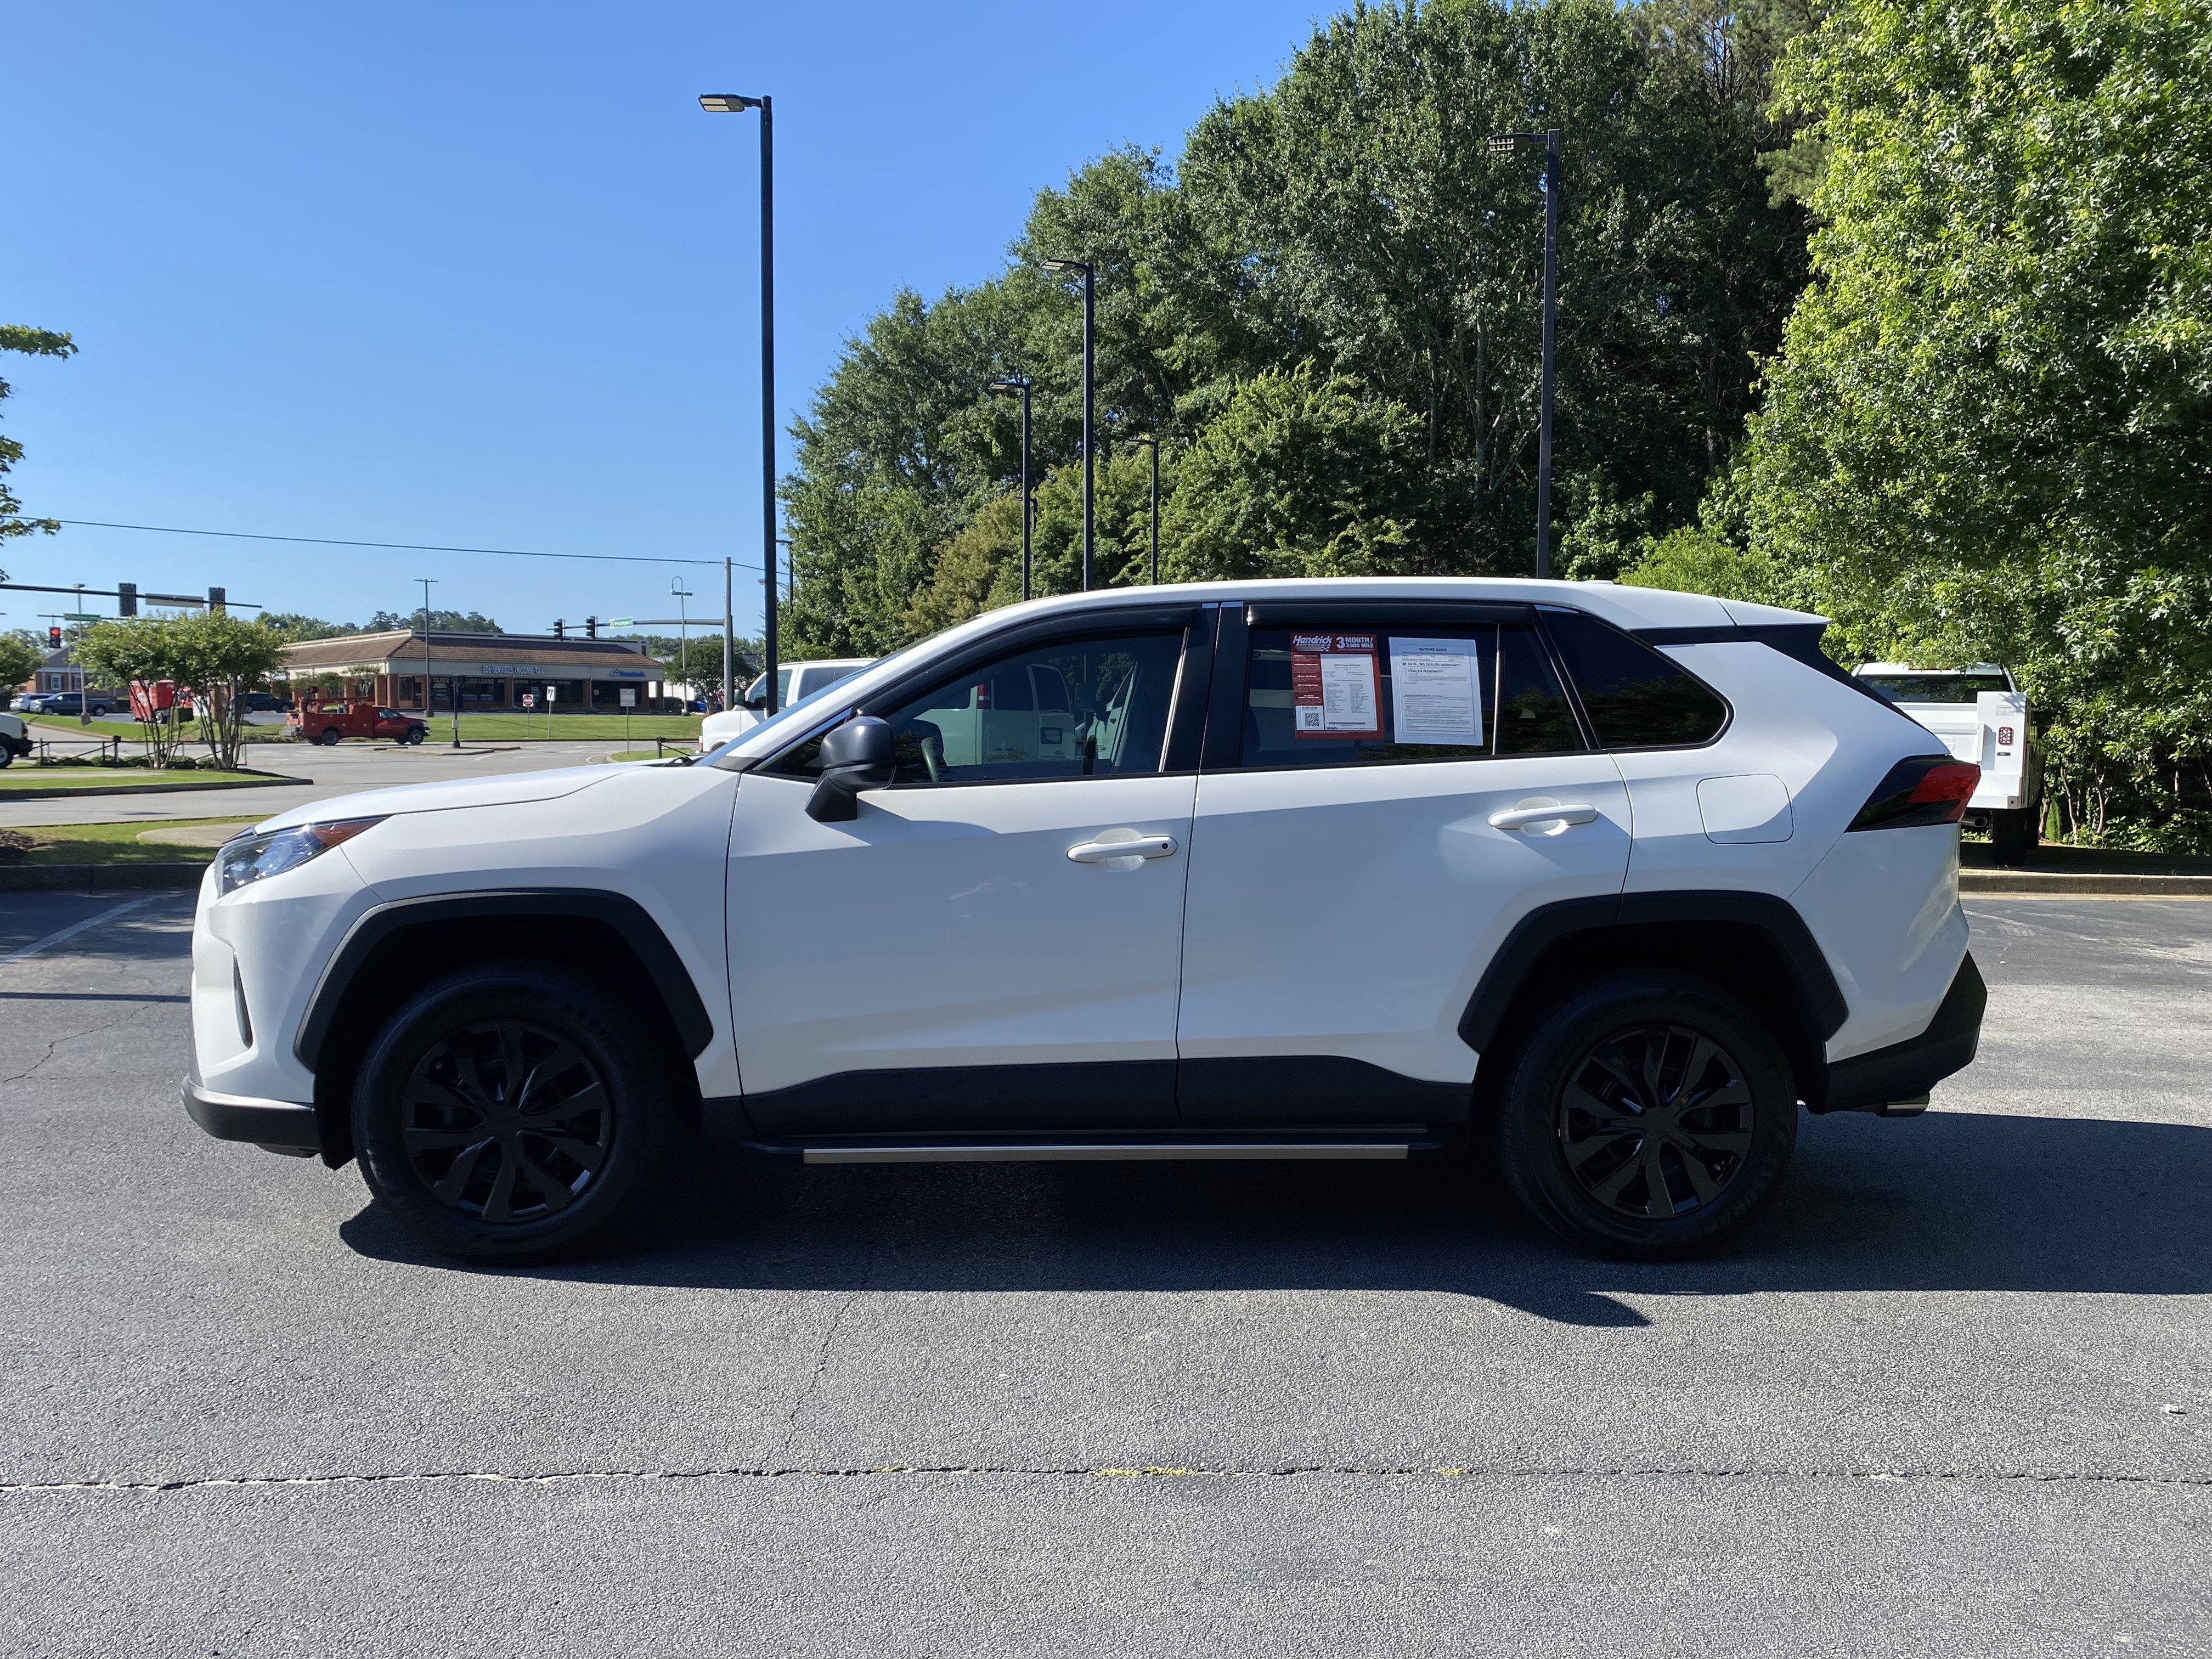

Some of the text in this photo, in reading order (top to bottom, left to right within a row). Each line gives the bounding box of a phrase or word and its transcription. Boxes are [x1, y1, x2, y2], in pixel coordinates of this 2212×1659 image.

[1293, 635, 1333, 646] Hendrick
[1336, 636, 1345, 648] 3
[492, 665, 513, 674] SERVICES
[515, 666, 534, 674] INCOME
[534, 667, 544, 675] TAX
